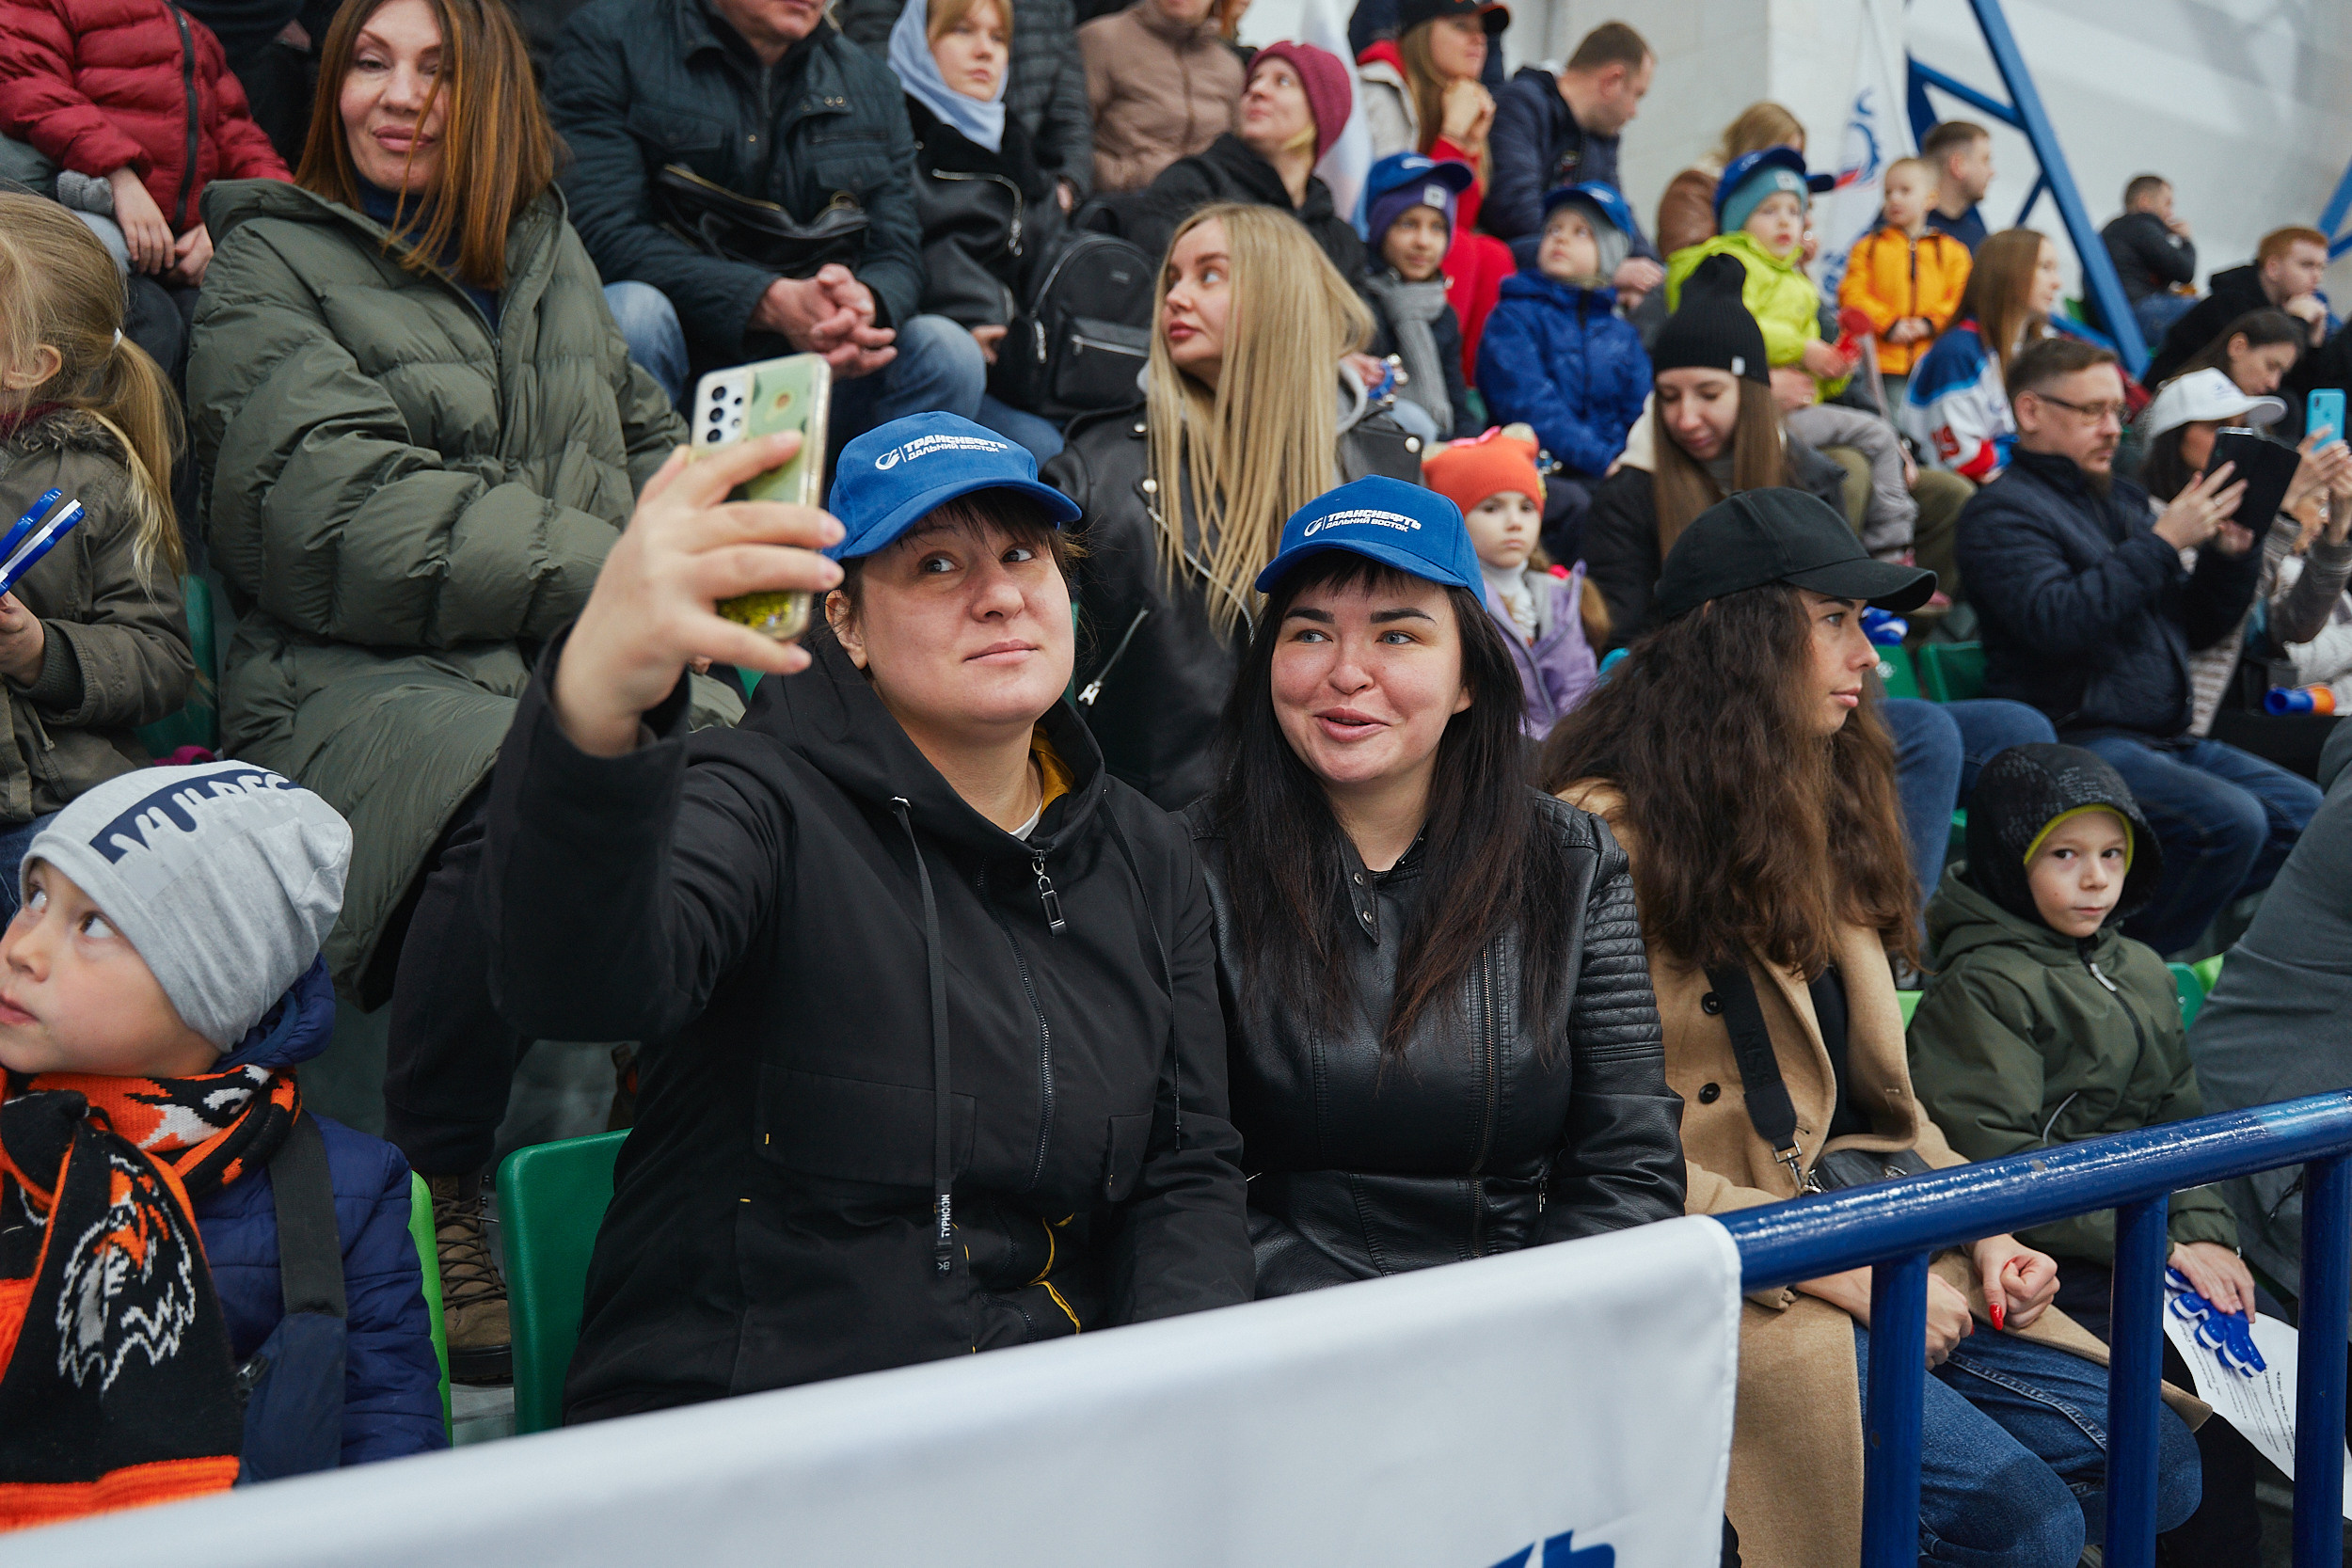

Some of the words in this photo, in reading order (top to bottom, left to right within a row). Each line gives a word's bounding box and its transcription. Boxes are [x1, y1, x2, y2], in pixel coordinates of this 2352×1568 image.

[903, 434, 1008, 452] ТРАНСНЕФТЬ
[907, 442, 959, 461] ДАЛЬНИЙ
[960, 444, 1000, 452] ВОСТОК
[1325, 517, 1371, 529] ДАЛЬНИЙ
[1371, 518, 1408, 532] ВОСТОК
[1327, 509, 1422, 531] ТРАНСНЕФТЬ
[941, 1194, 950, 1238] TYPHOON
